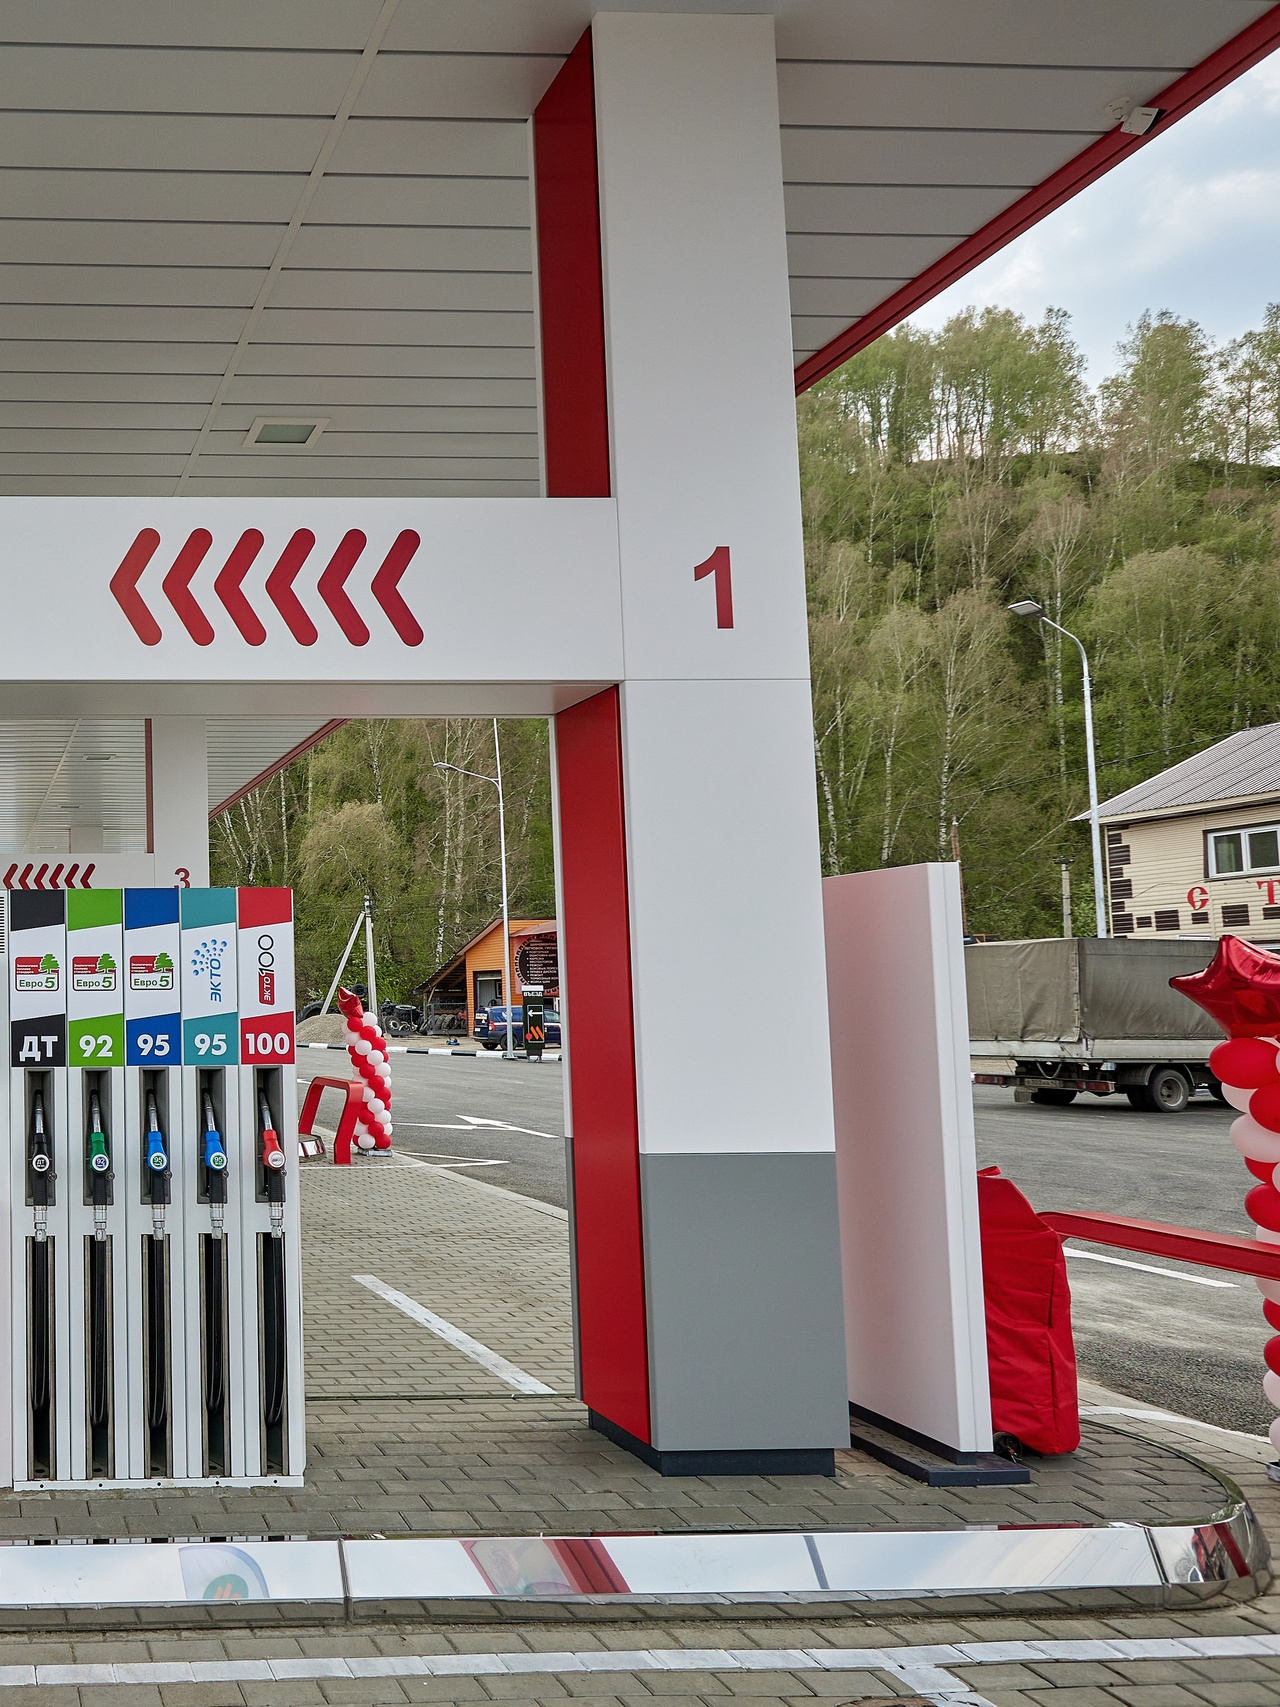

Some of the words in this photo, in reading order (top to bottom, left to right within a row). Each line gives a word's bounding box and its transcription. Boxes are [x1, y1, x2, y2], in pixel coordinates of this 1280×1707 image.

[693, 545, 734, 629] 1
[173, 867, 191, 889] 3
[19, 980, 43, 988] Евро
[44, 976, 56, 988] 5
[76, 980, 100, 988] Евро
[101, 976, 112, 988] 5
[133, 978, 157, 988] Евро
[158, 976, 170, 988] 5
[210, 958, 222, 1002] ЭКТО
[263, 976, 271, 1002] ЭКТО
[19, 1035, 58, 1062] ДТ
[78, 1035, 113, 1058] 92
[136, 1034, 170, 1056] 95
[194, 1034, 228, 1056] 95
[245, 1032, 290, 1055] 100
